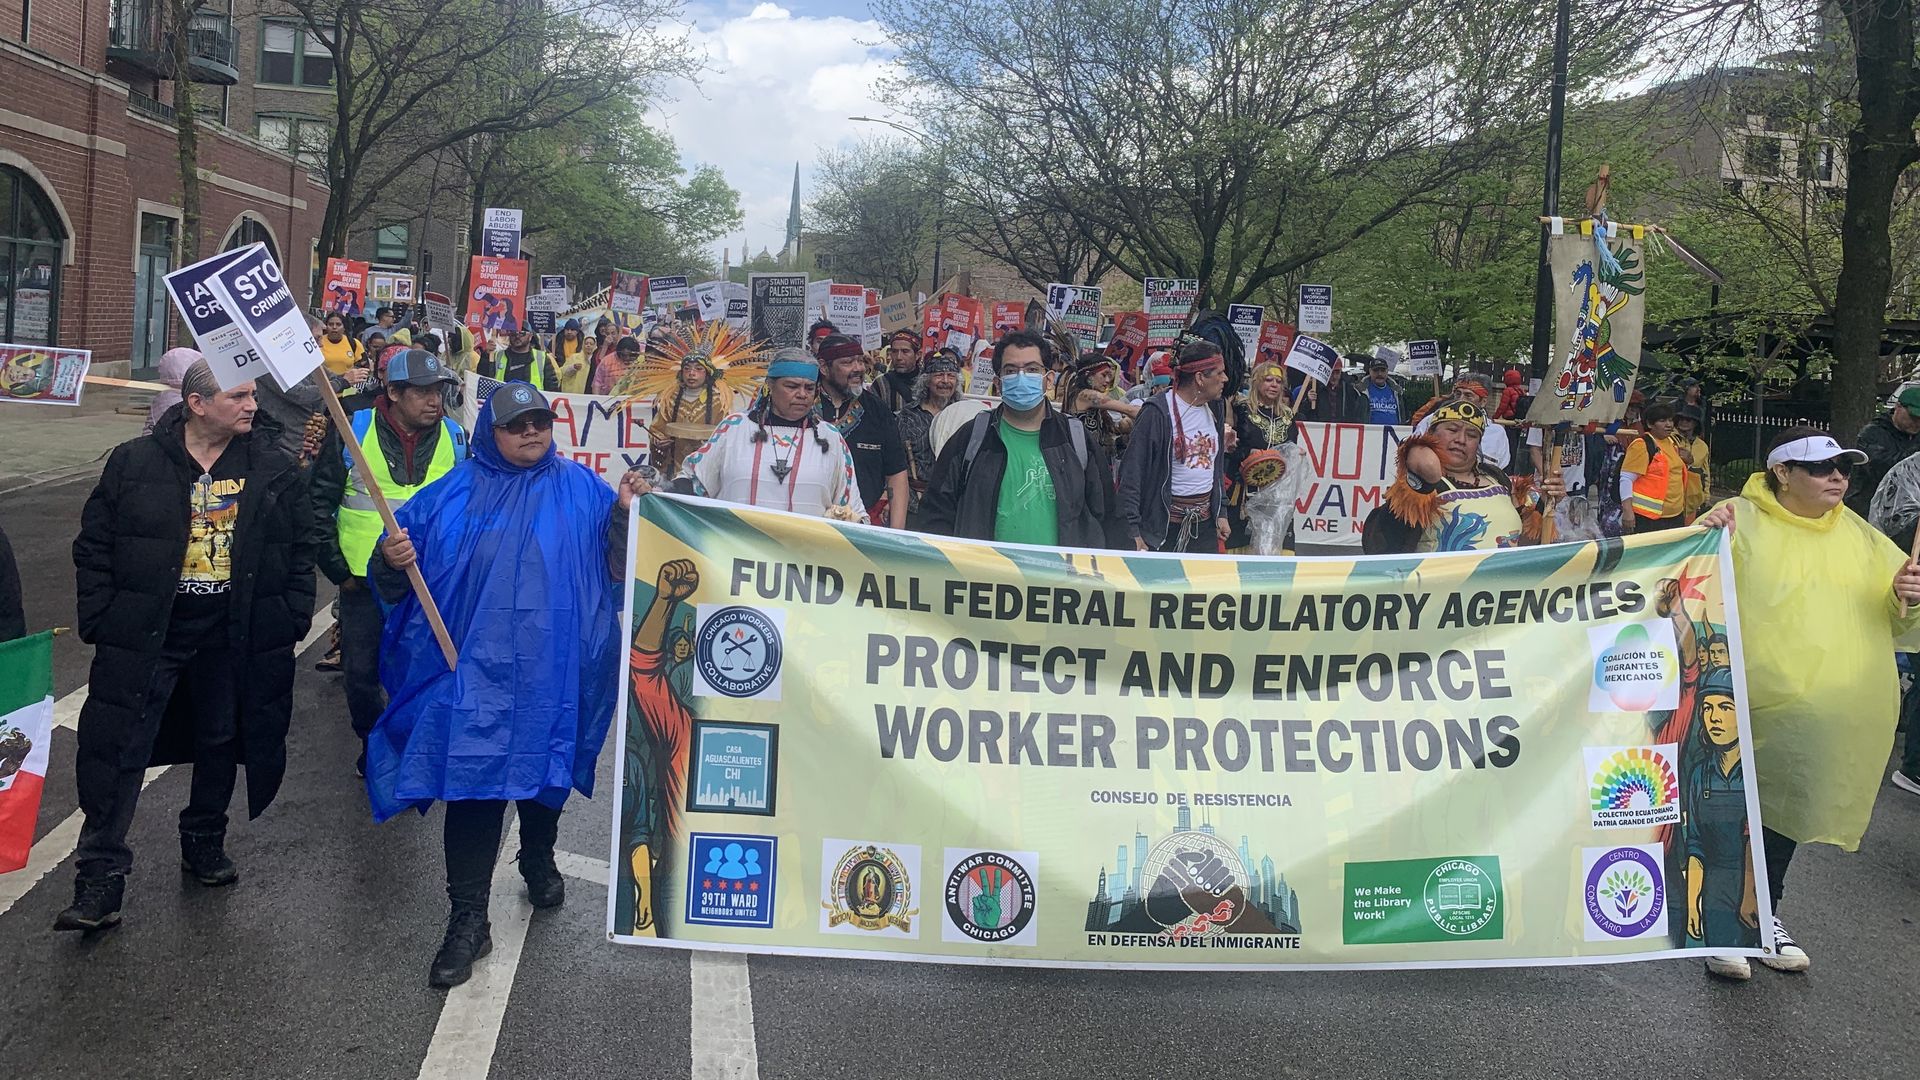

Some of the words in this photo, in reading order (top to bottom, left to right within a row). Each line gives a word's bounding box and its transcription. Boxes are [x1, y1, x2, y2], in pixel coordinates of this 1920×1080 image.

[480, 265, 499, 273] STOP
[480, 272, 519, 281] DEPORTATIONS
[492, 280, 518, 289] DEFEND
[1152, 280, 1175, 291] STOP
[1178, 280, 1197, 291] THE
[769, 286, 804, 296] PALESTINE!
[1080, 289, 1099, 301] THE
[251, 284, 290, 317] CRIMIN
[729, 302, 748, 310] STOP
[1299, 339, 1324, 352] STOP
[1302, 517, 1338, 533] ARE
[730, 557, 844, 605] FUND
[855, 572, 931, 613] ALL
[944, 579, 1136, 628] FEDERAL
[1149, 592, 1431, 631] REGULATORY
[1437, 580, 1647, 629] AGENCIES
[705, 613, 737, 640] CHICAGO
[739, 613, 775, 644] WORKERS
[1602, 651, 1646, 663] COALICIÓN
[1650, 651, 1664, 659] DE
[865, 633, 1106, 697] PROTECT
[1119, 649, 1235, 699] AND
[1252, 649, 1512, 702] ENFORCE
[1604, 662, 1659, 672] MIGRANTES
[704, 661, 773, 691] COLLABORATIVE
[1604, 672, 1663, 682] MEXICANOS
[874, 703, 1117, 769] WORKER
[1136, 715, 1521, 773] PROTECTIONS
[726, 745, 742, 754] CASA
[705, 754, 762, 766] AGUASCALIENTES
[724, 767, 741, 780] CHI
[1090, 790, 1158, 805] CONSEJO
[1167, 792, 1186, 806] DE
[1194, 793, 1292, 807] RESISTENCIA
[1635, 806, 1674, 814] ECUATORIANO
[1593, 819, 1617, 827] PATRIA
[1618, 818, 1646, 826] GRANDE
[1655, 813, 1679, 822] CHICAGO
[1608, 850, 1640, 862] CENTRO
[1435, 862, 1480, 877] CHICAGO
[948, 856, 983, 904] ANTI-WAR
[987, 855, 1033, 909] COMMITTEE
[1354, 887, 1371, 896] We
[1374, 886, 1401, 895] Make
[701, 892, 727, 907] 39TH
[731, 893, 758, 908] WARD
[1354, 899, 1371, 908] the
[1374, 897, 1412, 908] Library
[701, 906, 733, 916] NEIGHBORS
[734, 907, 757, 917] UNITED
[1426, 898, 1457, 932] PUBLIC
[1460, 897, 1495, 933] LIBRARY
[1587, 884, 1622, 934] COMUNITARIO
[1639, 918, 1652, 929] LA
[1649, 885, 1663, 918] VILLITA
[1354, 911, 1386, 920] Work!
[962, 922, 1016, 939] CHICAGO
[1087, 934, 1106, 946] EN
[1110, 934, 1176, 948] DEFENSA
[1180, 935, 1207, 948] DEL
[1211, 936, 1300, 949] INMIGRANTE
